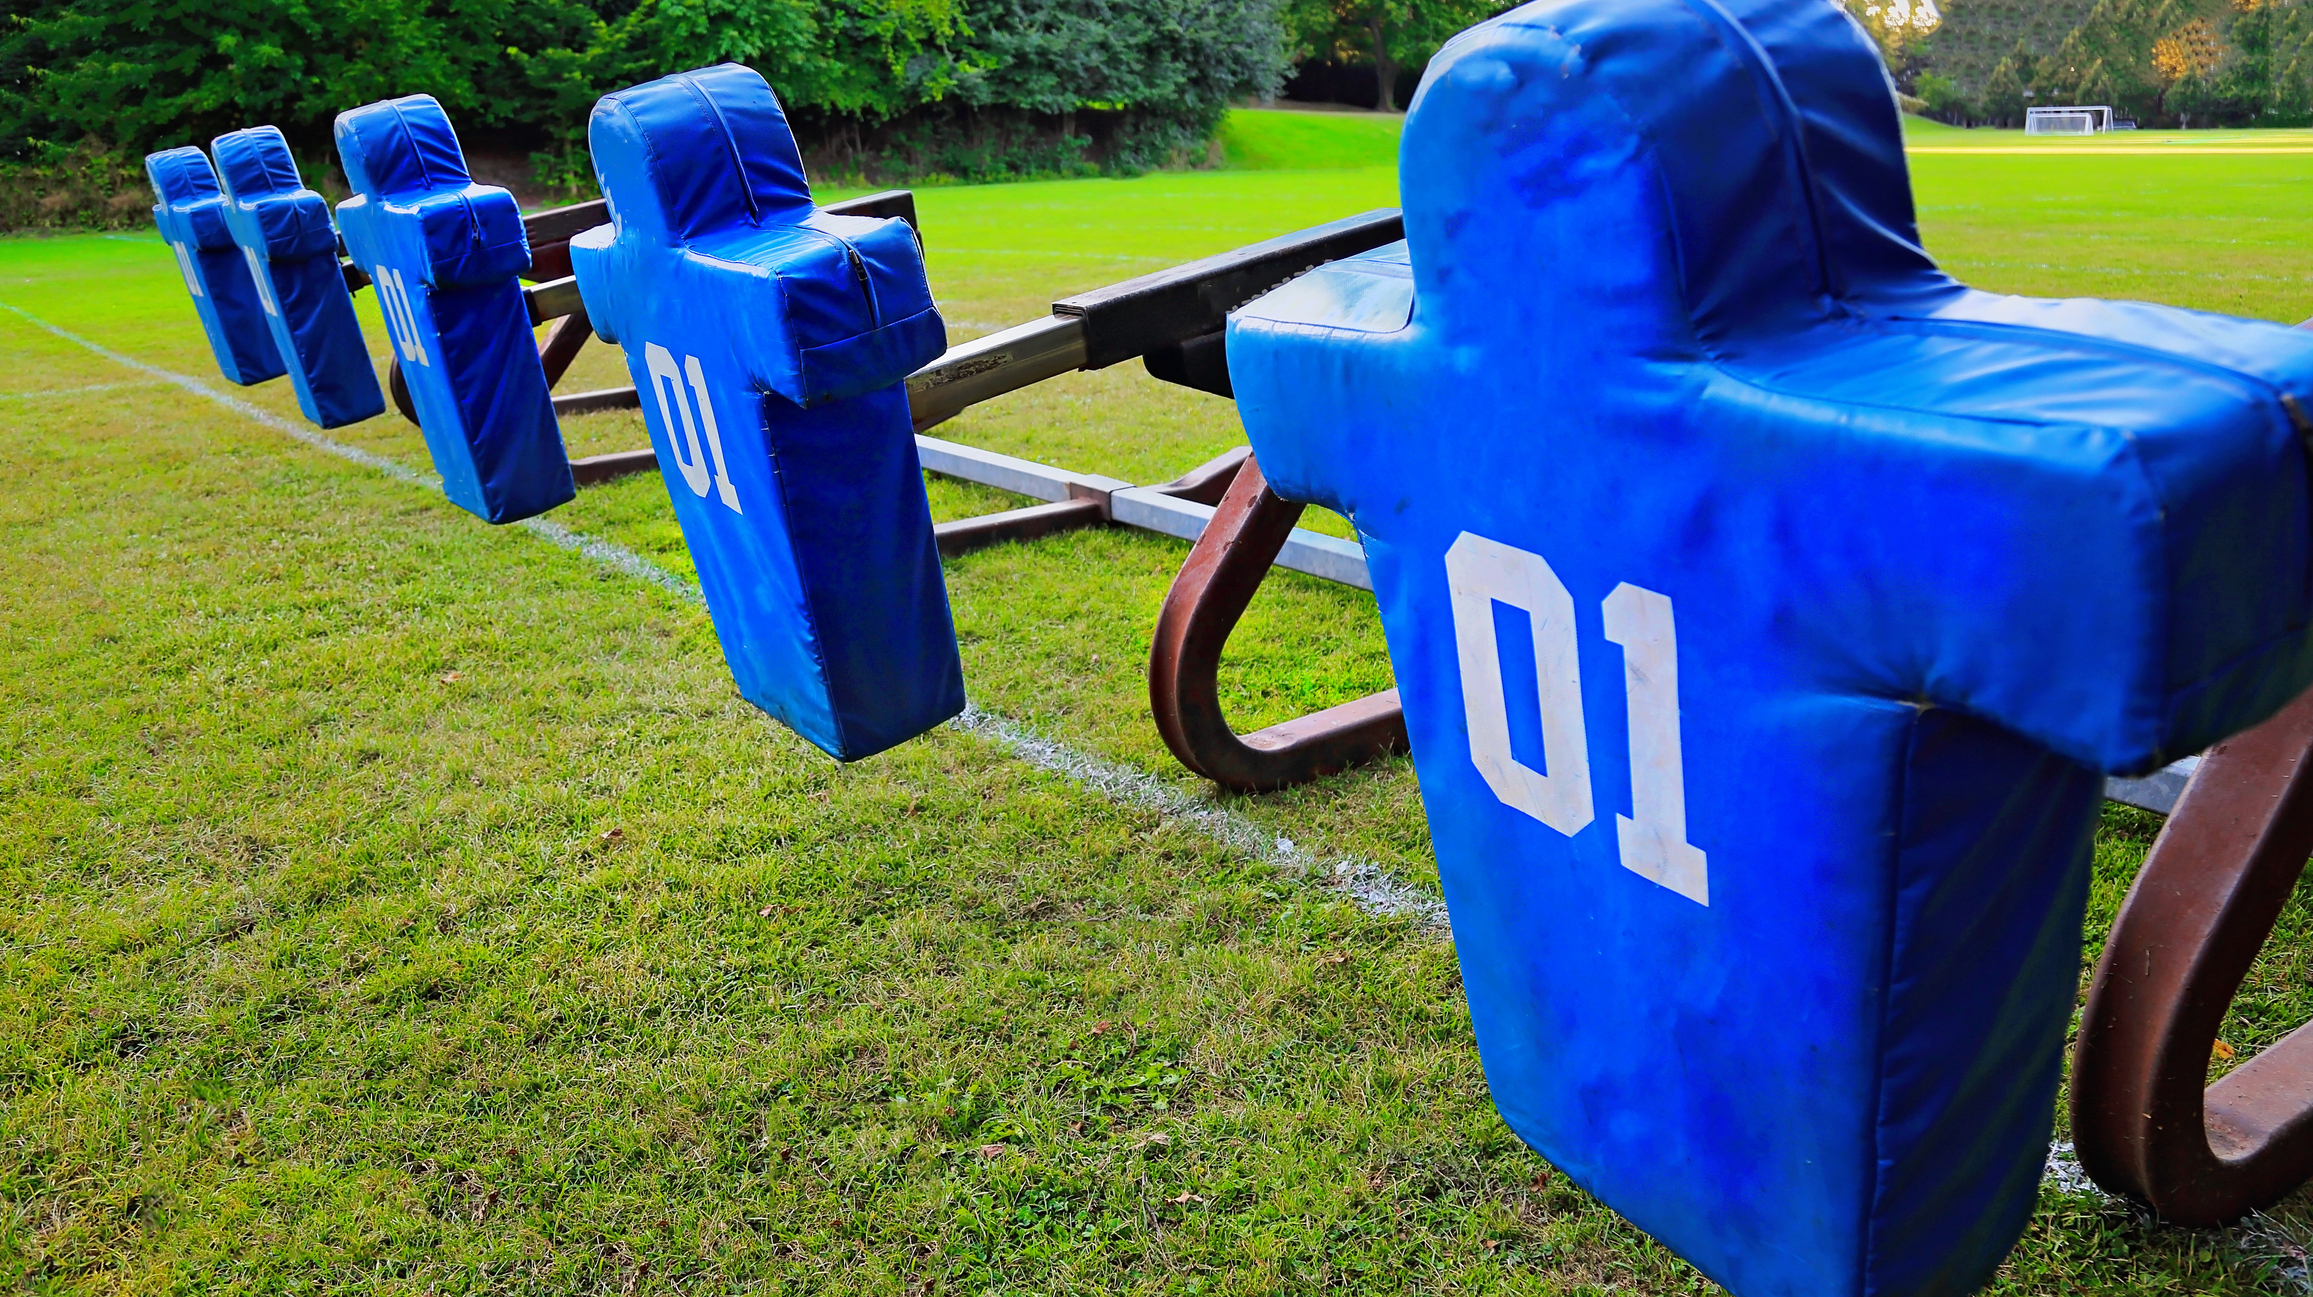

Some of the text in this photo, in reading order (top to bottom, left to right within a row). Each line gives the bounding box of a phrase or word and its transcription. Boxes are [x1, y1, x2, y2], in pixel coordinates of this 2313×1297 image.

[375, 264, 430, 368] 01
[645, 341, 743, 516] 01
[1444, 530, 1710, 908] 01
